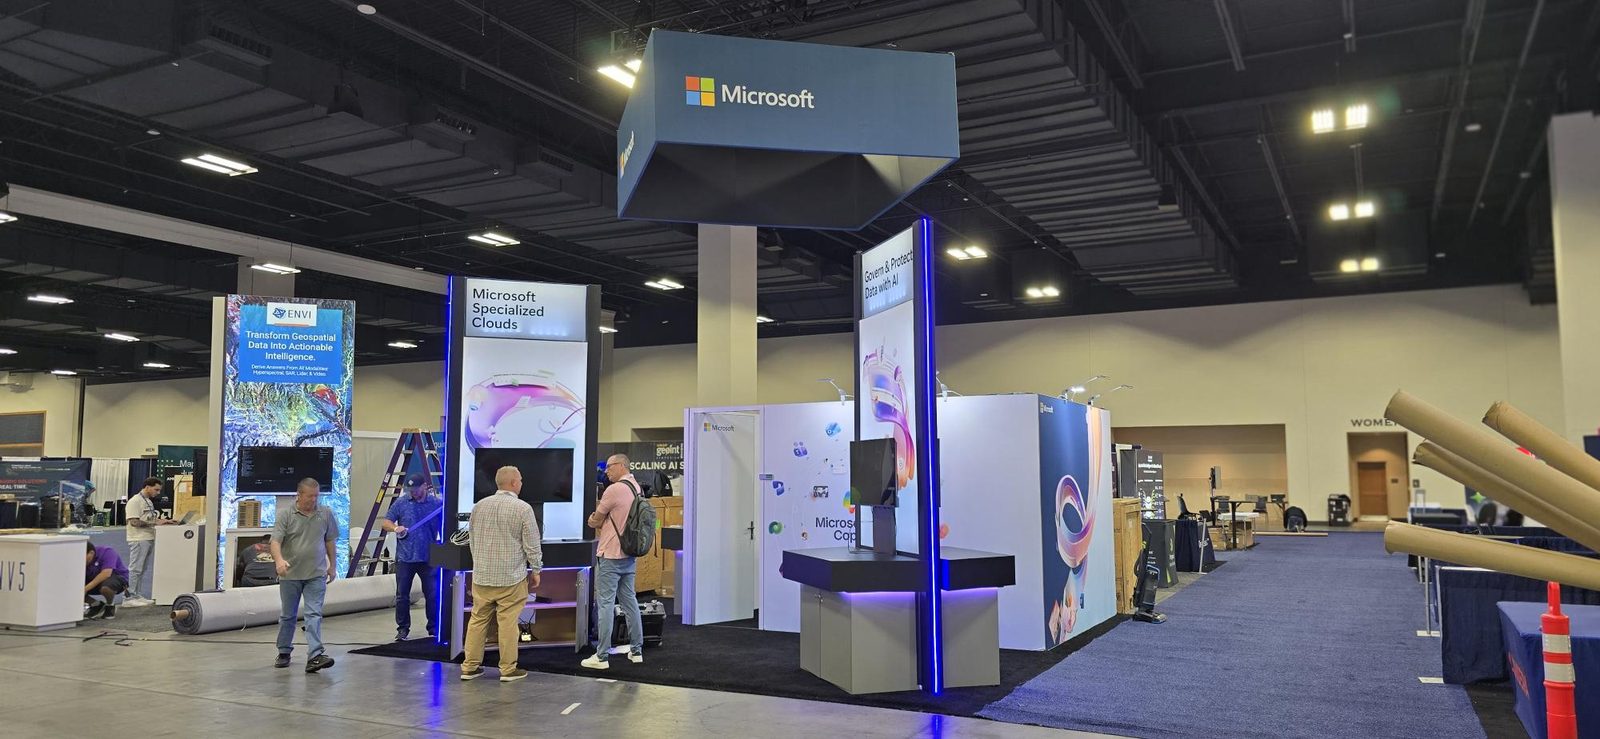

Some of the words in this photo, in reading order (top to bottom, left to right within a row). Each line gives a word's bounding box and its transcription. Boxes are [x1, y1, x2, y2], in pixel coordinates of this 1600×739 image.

[721, 84, 815, 109] Microsoft
[865, 265, 884, 283] Govern
[884, 260, 890, 273] &
[890, 249, 913, 270] Protect
[865, 286, 878, 299] Data
[878, 276, 891, 293] with
[892, 272, 899, 288] AI
[473, 288, 536, 302] Microsoft
[287, 309, 311, 319] ENVI
[472, 302, 544, 317] Specialized
[472, 317, 518, 330] Clouds
[246, 331, 290, 340] Transform
[291, 332, 336, 342] Geospatial
[248, 341, 268, 349] Data
[270, 342, 287, 350] Into
[289, 343, 333, 352] Actionable
[265, 352, 316, 361] Intelligence.
[712, 424, 735, 432] Microsoft
[1351, 418, 1397, 427] WOME
[629, 462, 667, 470] SCALING
[669, 462, 678, 470] AI
[815, 517, 856, 528] Micros
